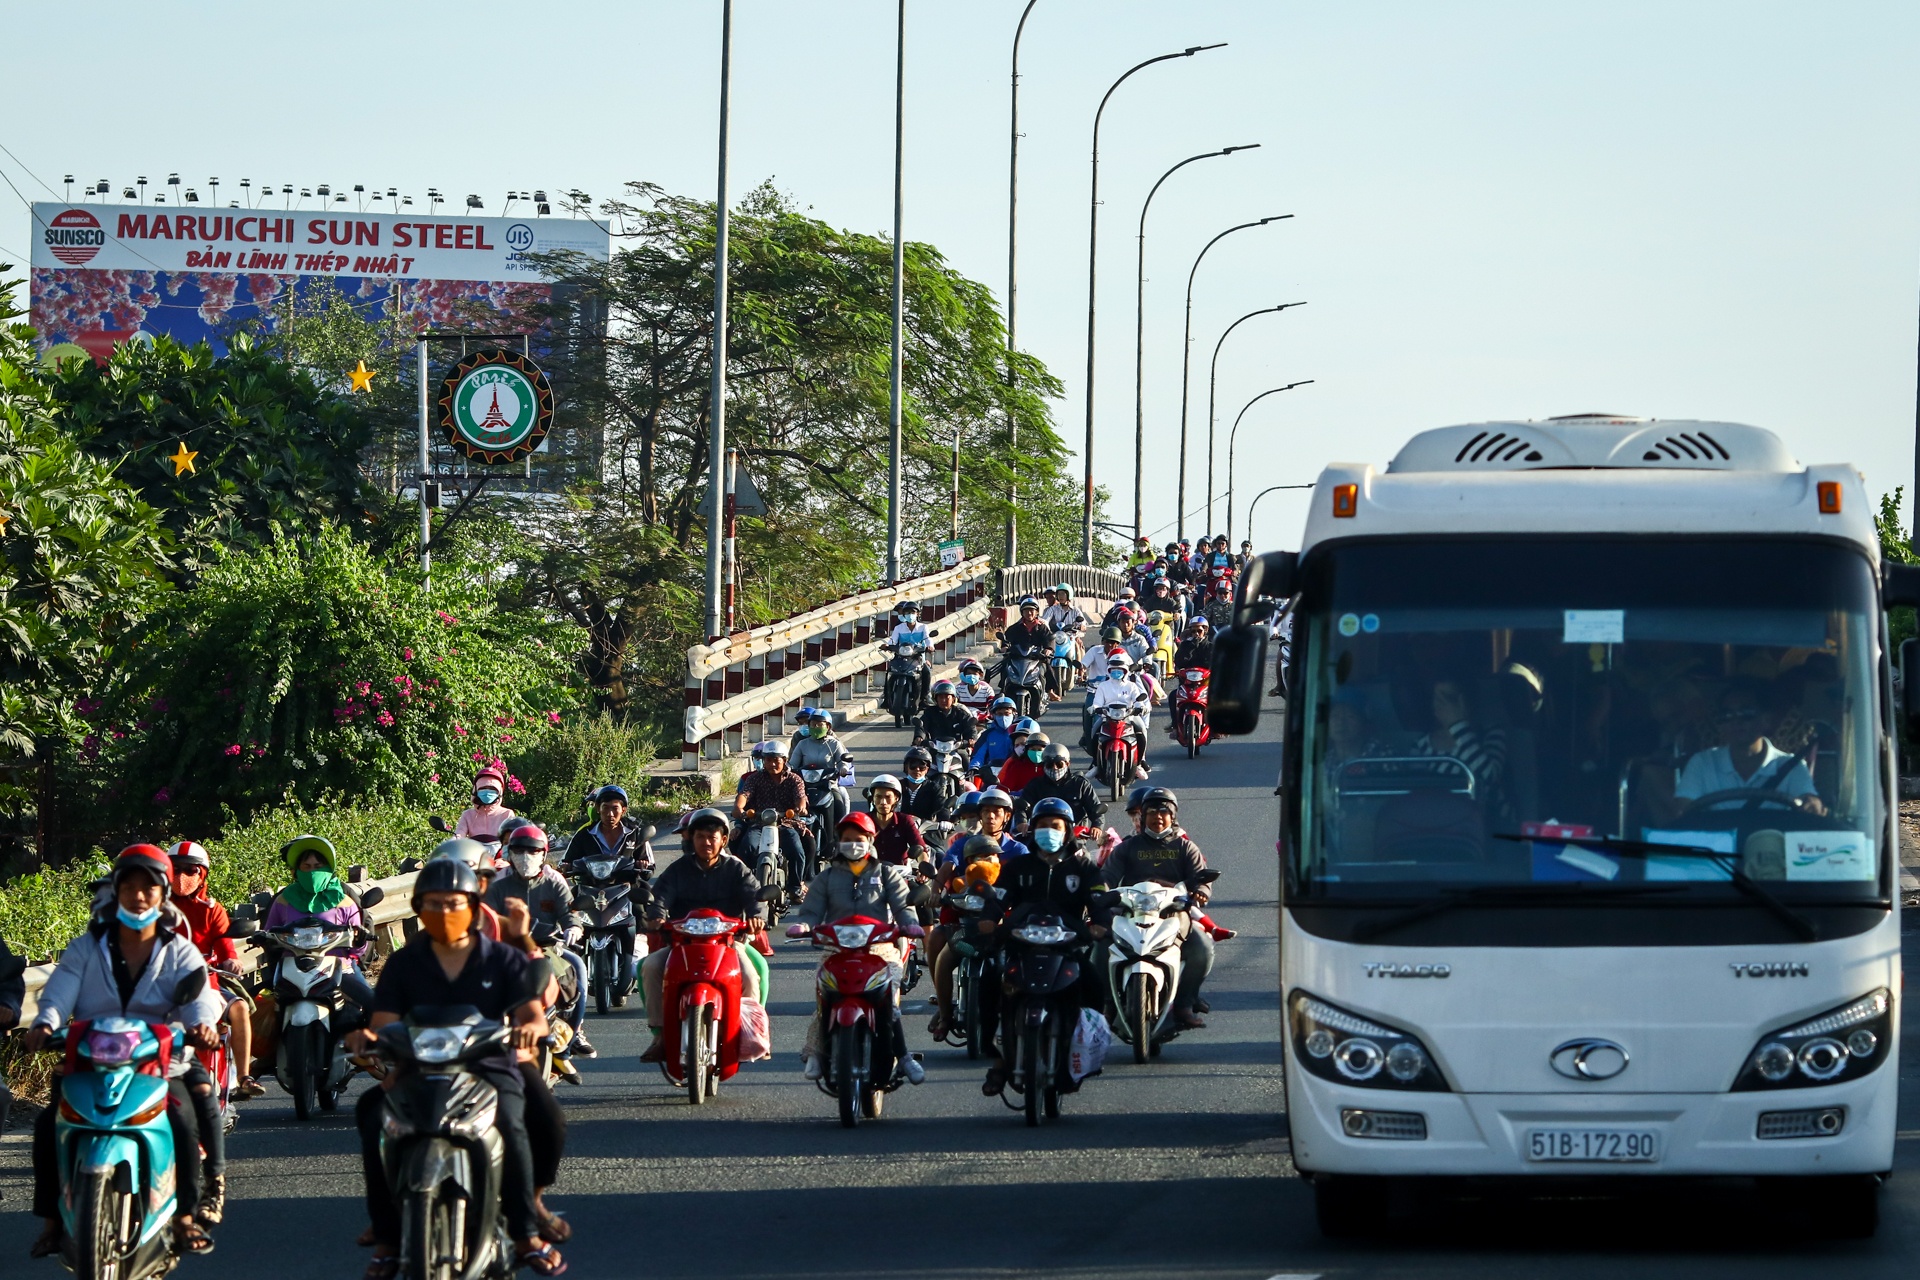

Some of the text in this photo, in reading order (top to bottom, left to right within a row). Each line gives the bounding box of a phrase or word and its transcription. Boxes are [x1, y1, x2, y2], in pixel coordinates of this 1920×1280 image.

[61, 216, 91, 224] MARUICHI
[45, 229, 105, 246] SUNSCO
[117, 213, 494, 251] MARUICHI SUN STEEL
[186, 245, 415, 277] BẢN LĨNH THÉP NHẬT
[505, 263, 517, 271] API
[942, 553, 957, 563] 379
[1154, 849, 1178, 860] ARMY
[1361, 962, 1451, 979] THACO
[1729, 962, 1809, 979] TOWN
